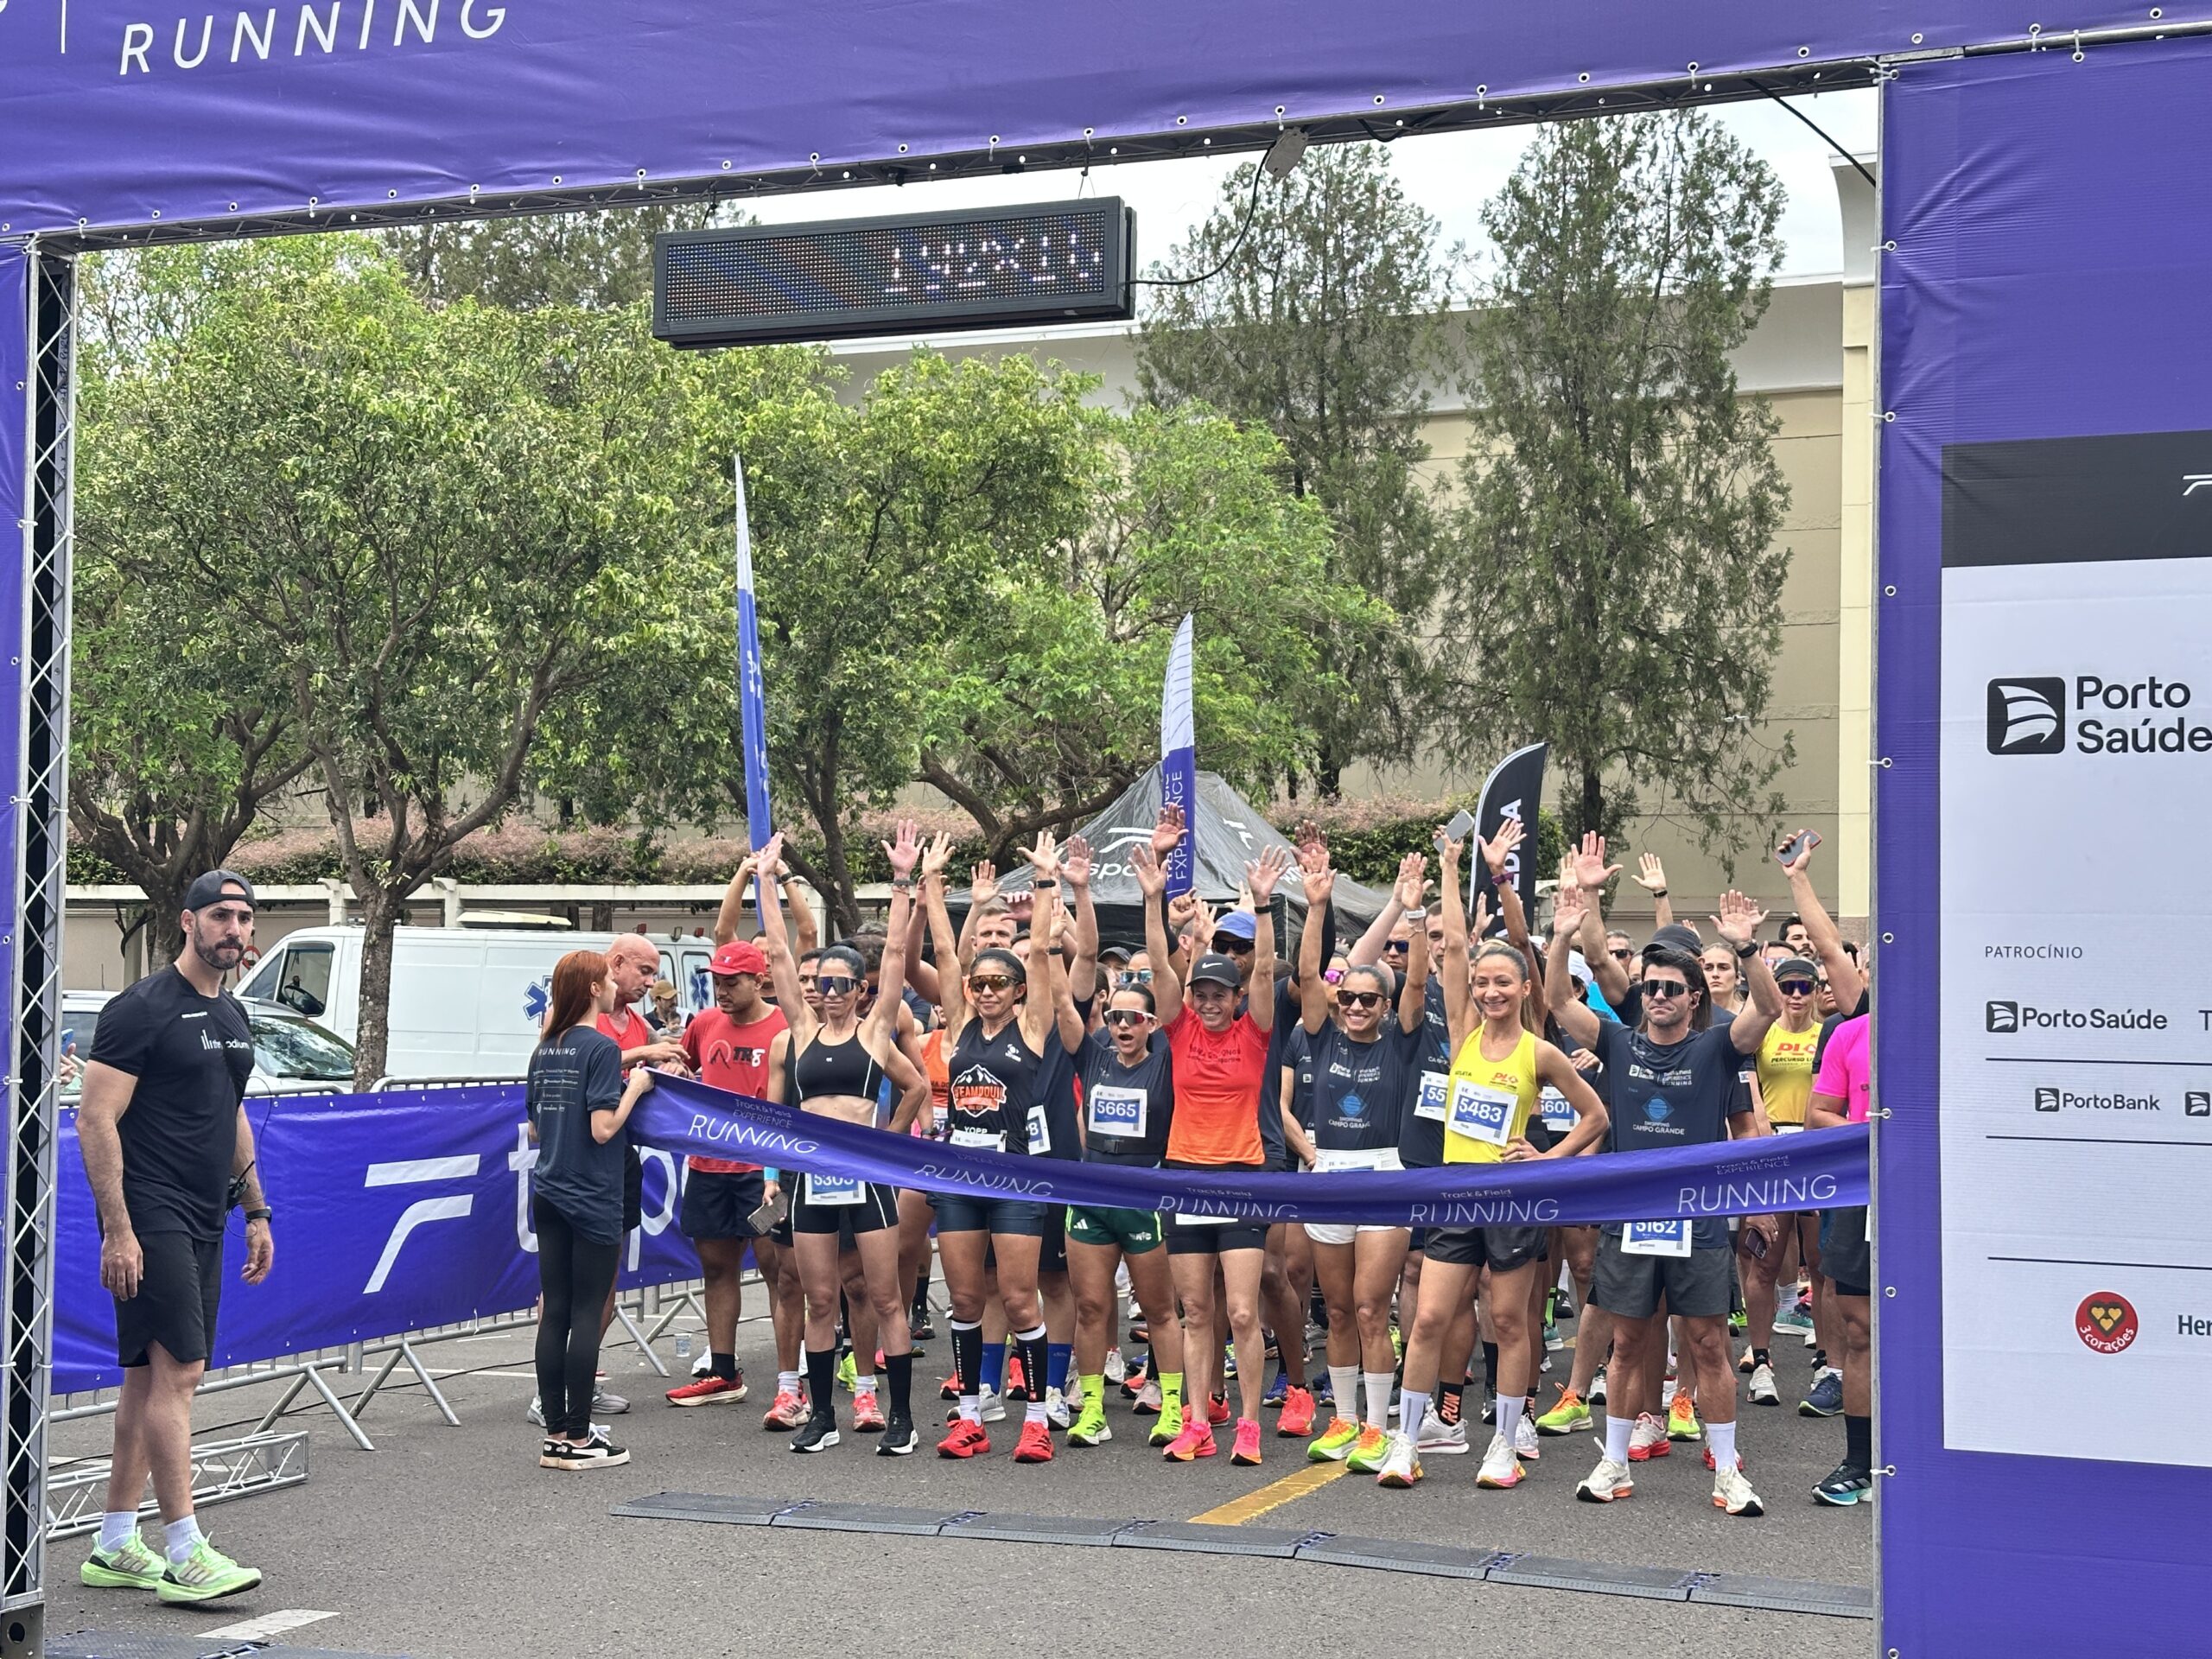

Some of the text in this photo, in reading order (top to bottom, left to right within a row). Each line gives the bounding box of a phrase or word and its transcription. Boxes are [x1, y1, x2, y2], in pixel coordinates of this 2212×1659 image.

[119, 0, 507, 75] RUNNING
[2076, 676, 2191, 710] Porto
[2076, 717, 2212, 754] Saúde
[1985, 944, 2083, 959] PATROCÍNIO
[733, 1109, 793, 1128] EXPERIENCE
[1096, 1100, 1136, 1117] 5665
[1459, 1097, 1502, 1122] 5483
[688, 1114, 819, 1154] RUNNING
[1632, 1124, 1654, 1133] CAMPO
[1716, 1160, 1790, 1175] EXPERIENCE
[914, 1164, 1053, 1197] RUNNING
[1440, 1189, 1512, 1198] Track&Field
[1677, 1174, 1837, 1213] RUNNING
[1410, 1198, 1559, 1223] RUNNING
[2080, 1325, 2134, 1351] 3 corações
[1441, 1391, 1460, 1423] RUN
